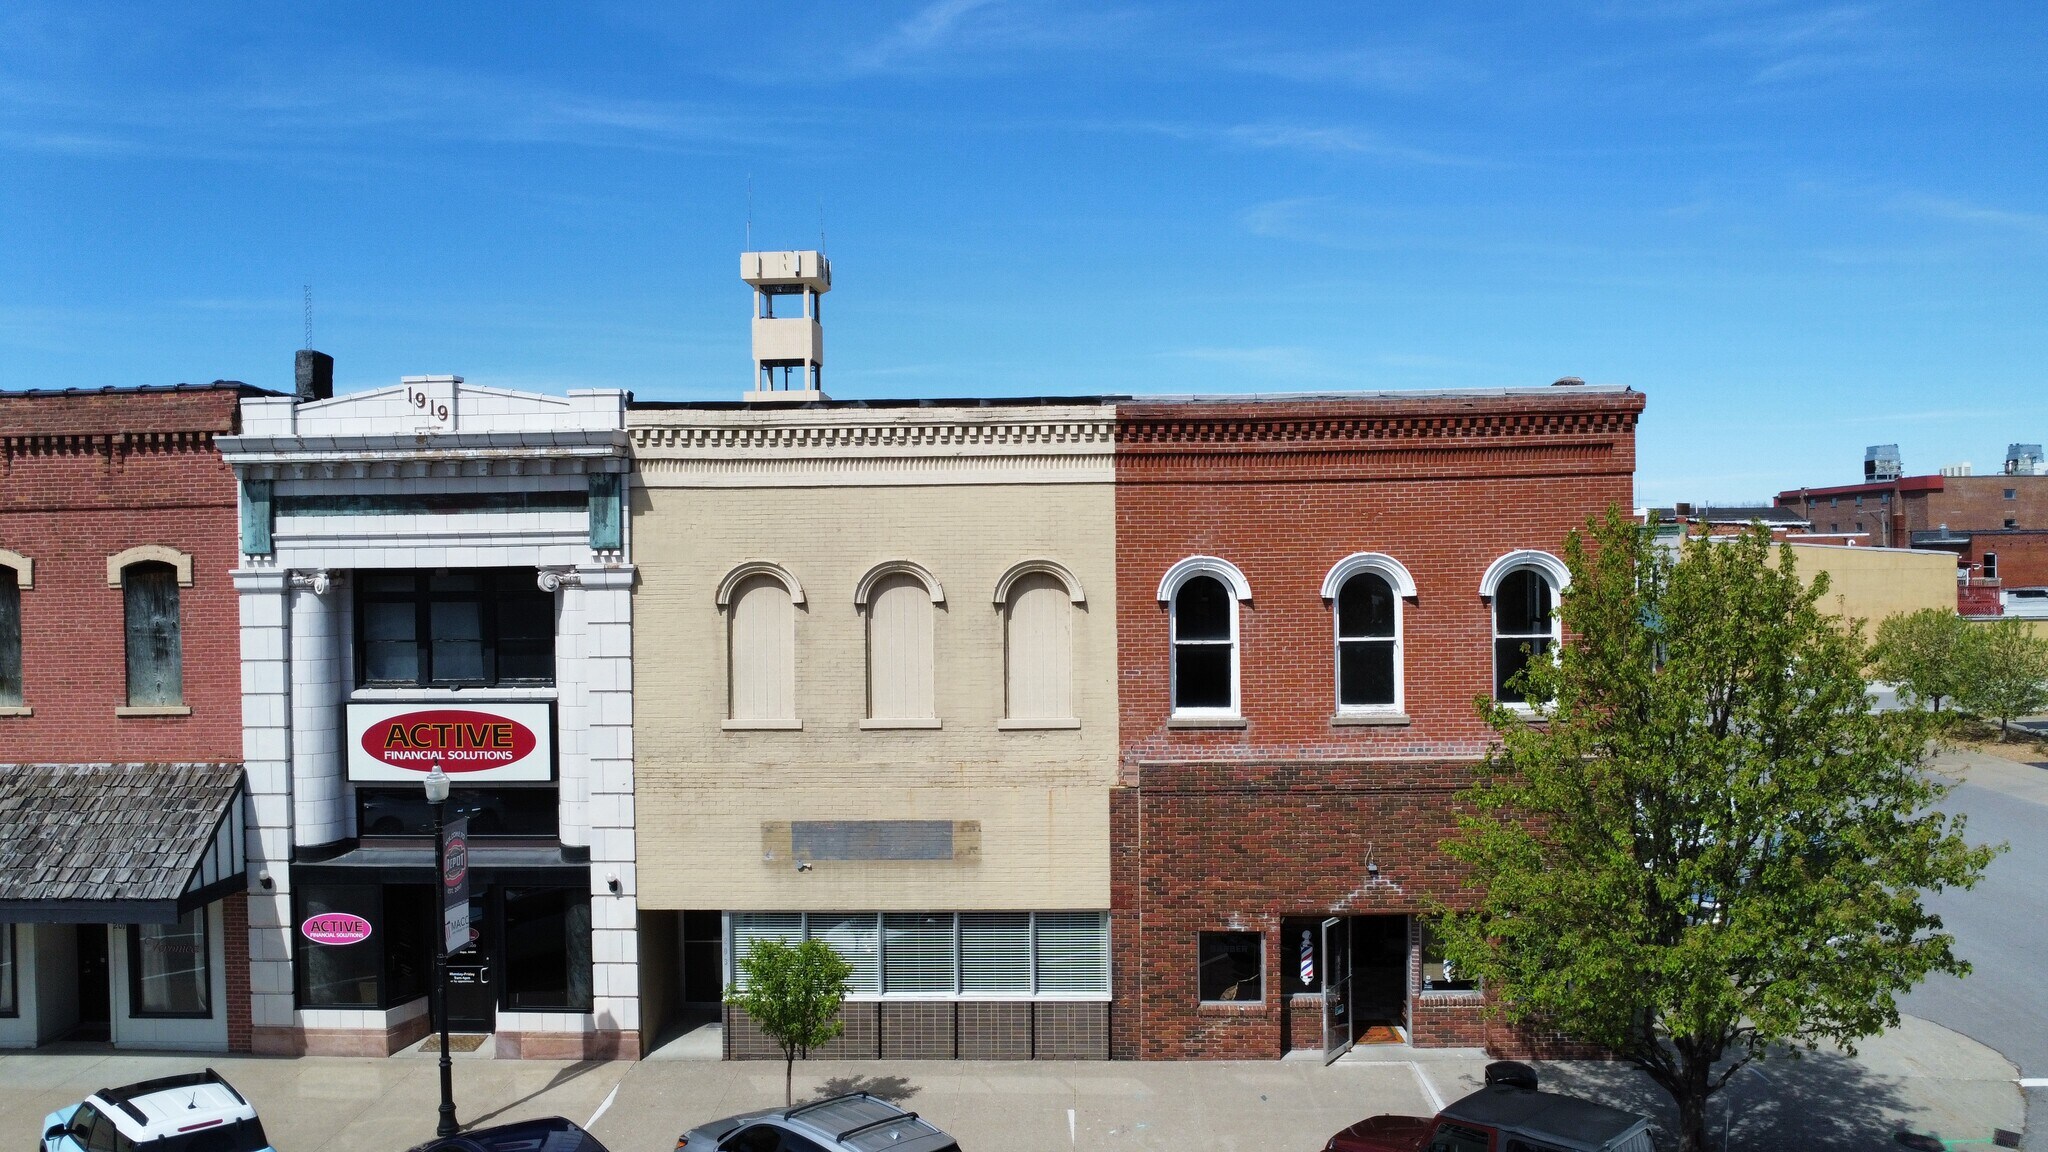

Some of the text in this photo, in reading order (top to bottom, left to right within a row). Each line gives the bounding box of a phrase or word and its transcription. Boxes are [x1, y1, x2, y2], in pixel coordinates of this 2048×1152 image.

[408, 386, 448, 421] 1919
[384, 723, 513, 749] ACTIVE
[384, 750, 513, 760] FINANCIAL SOLUTIONS
[447, 853, 465, 871] DEPOT
[310, 920, 363, 932] ACTIVE
[451, 915, 469, 931] MACC
